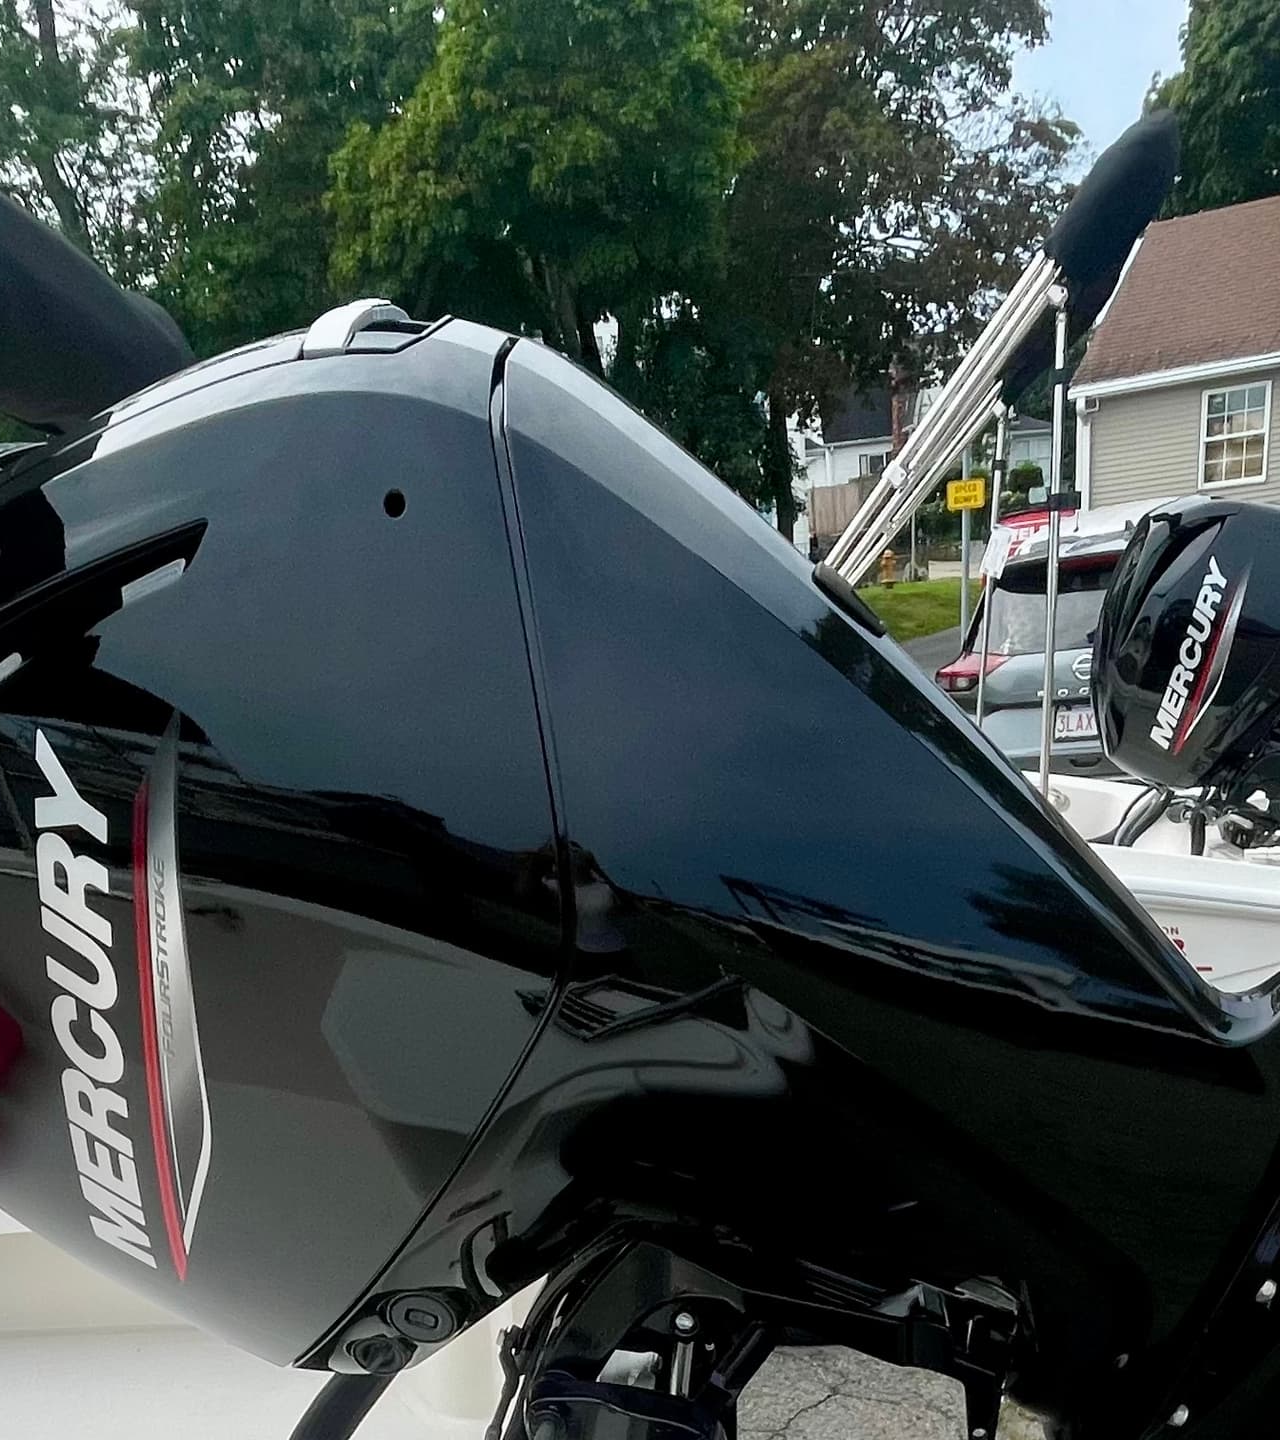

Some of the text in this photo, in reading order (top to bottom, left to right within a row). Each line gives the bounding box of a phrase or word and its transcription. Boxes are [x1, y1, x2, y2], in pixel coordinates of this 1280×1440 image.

[1149, 555, 1227, 750] MERCURY
[34, 727, 158, 1269] MERCURY
[152, 853, 175, 1057] FOURSTROKE
